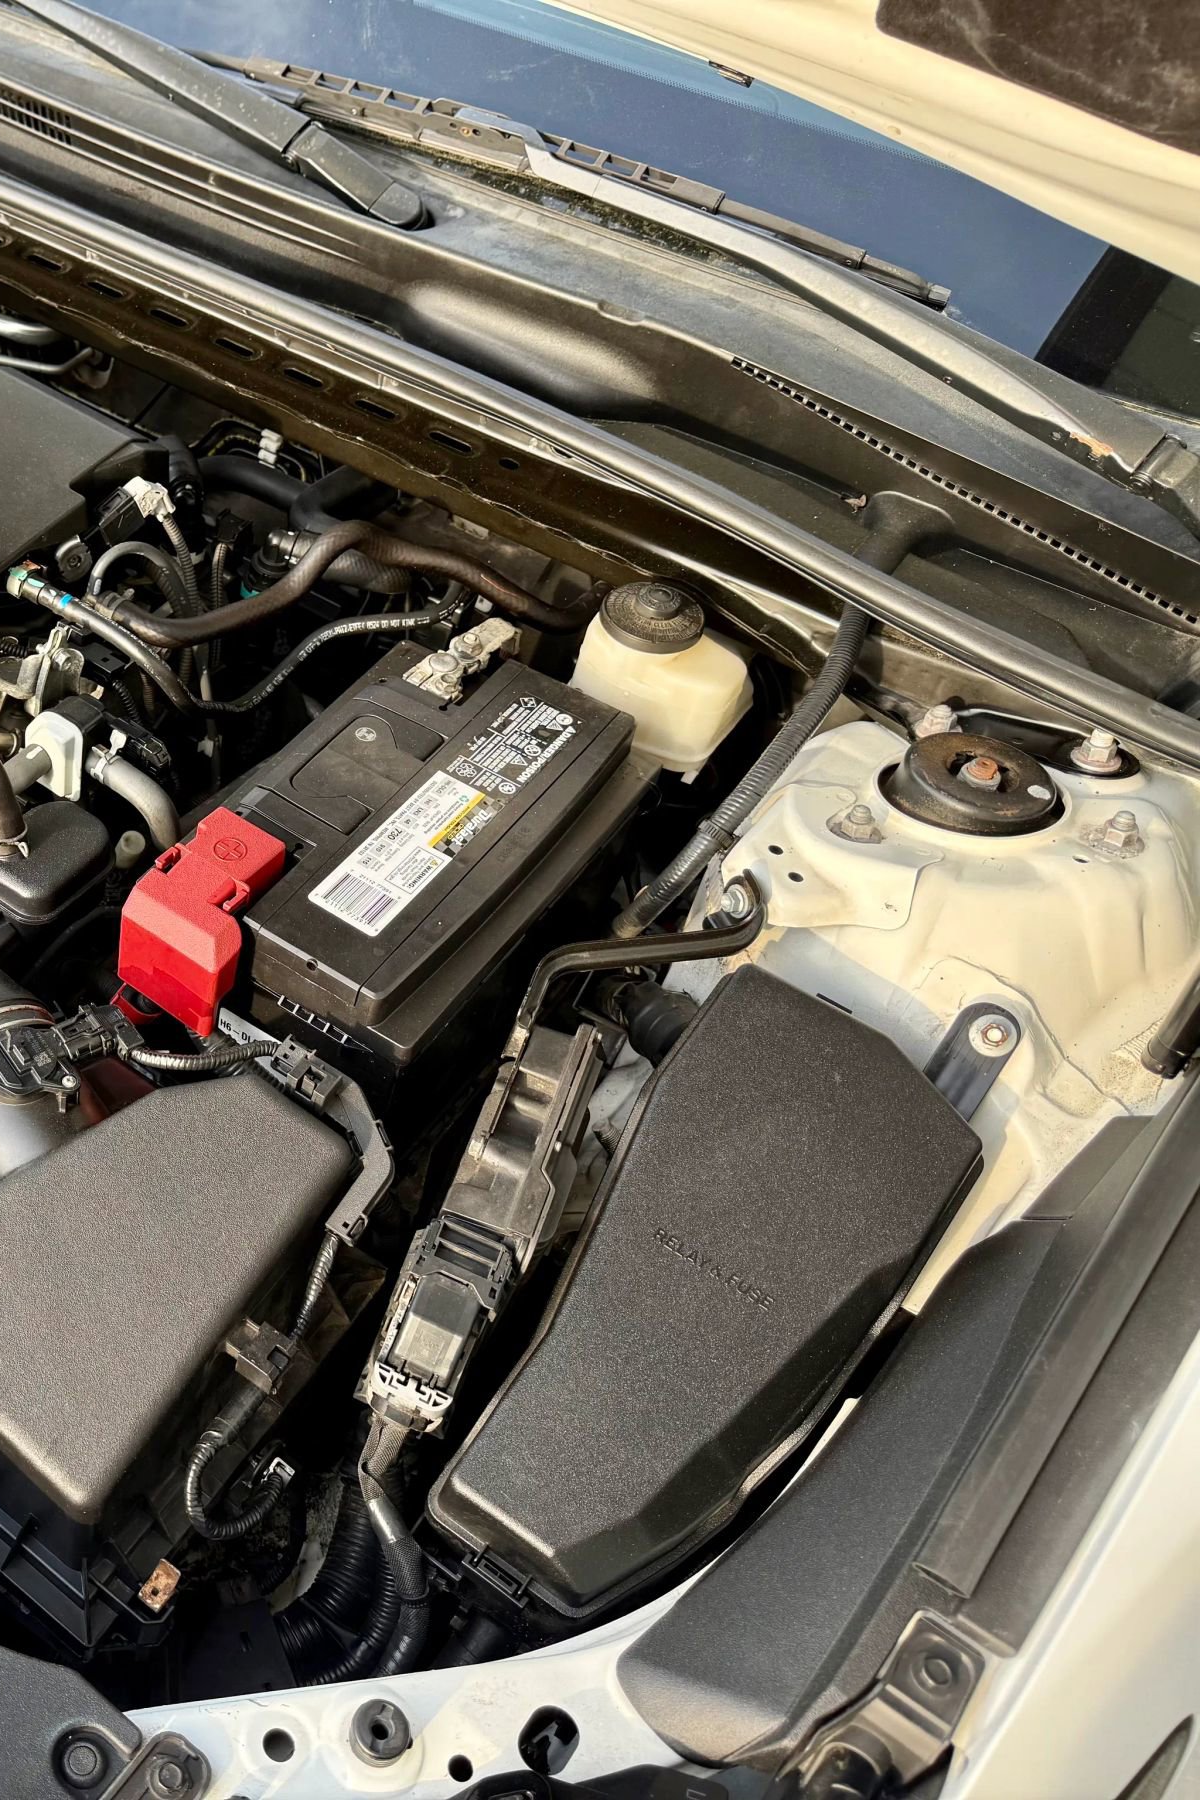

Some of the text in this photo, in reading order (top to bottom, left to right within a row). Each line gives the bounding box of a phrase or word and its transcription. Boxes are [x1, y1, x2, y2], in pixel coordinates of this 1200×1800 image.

[516, 731, 572, 783] DANGER/POISON
[384, 826, 403, 841] 730
[450, 810, 492, 847] Duralast
[408, 864, 433, 889] WARNING:
[652, 1227, 712, 1269] RELAY
[724, 1273, 776, 1312] FUSE
